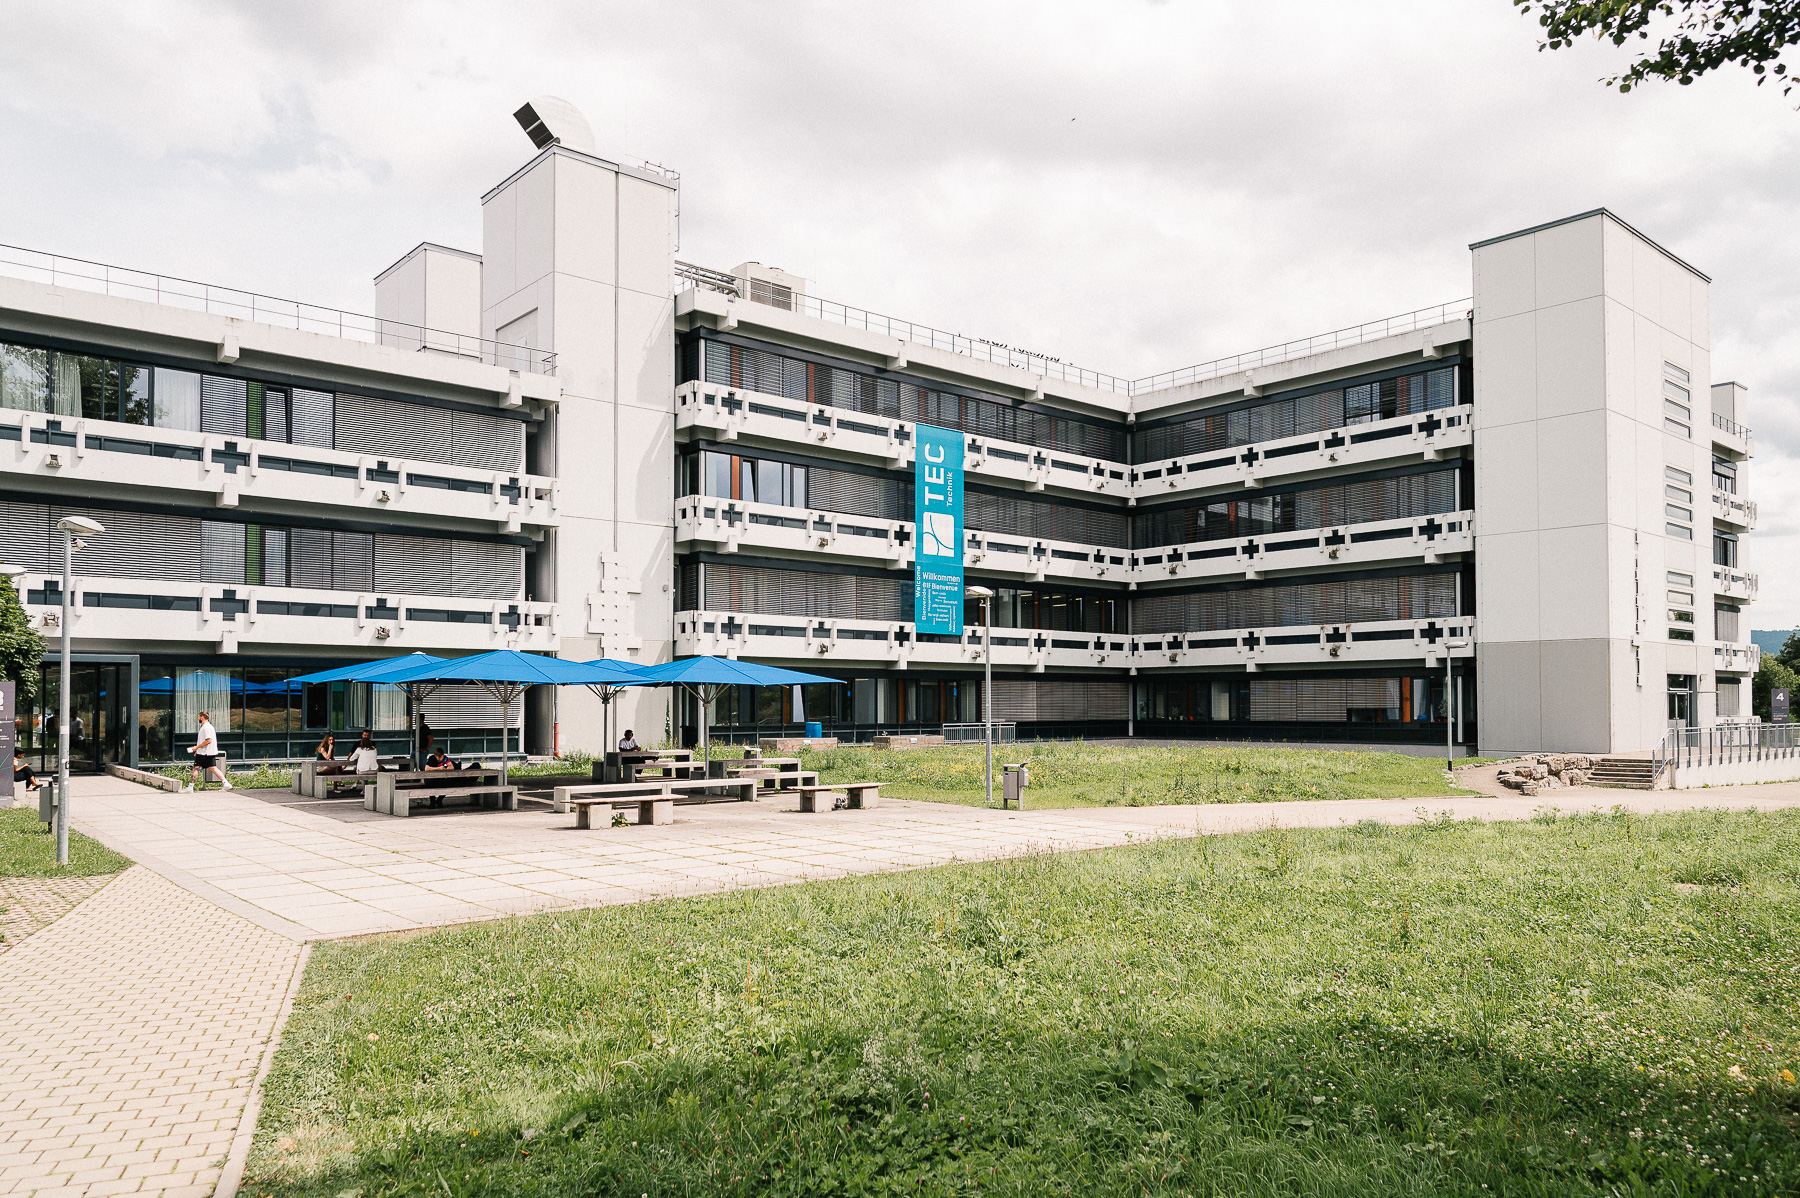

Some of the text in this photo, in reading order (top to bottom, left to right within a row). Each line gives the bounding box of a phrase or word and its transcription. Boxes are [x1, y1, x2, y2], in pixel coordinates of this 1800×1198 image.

[925, 443, 944, 505] TEC
[922, 572, 960, 582] Willkommen
[932, 583, 958, 591] Bienvenue
[1776, 692, 1784, 701] 4
